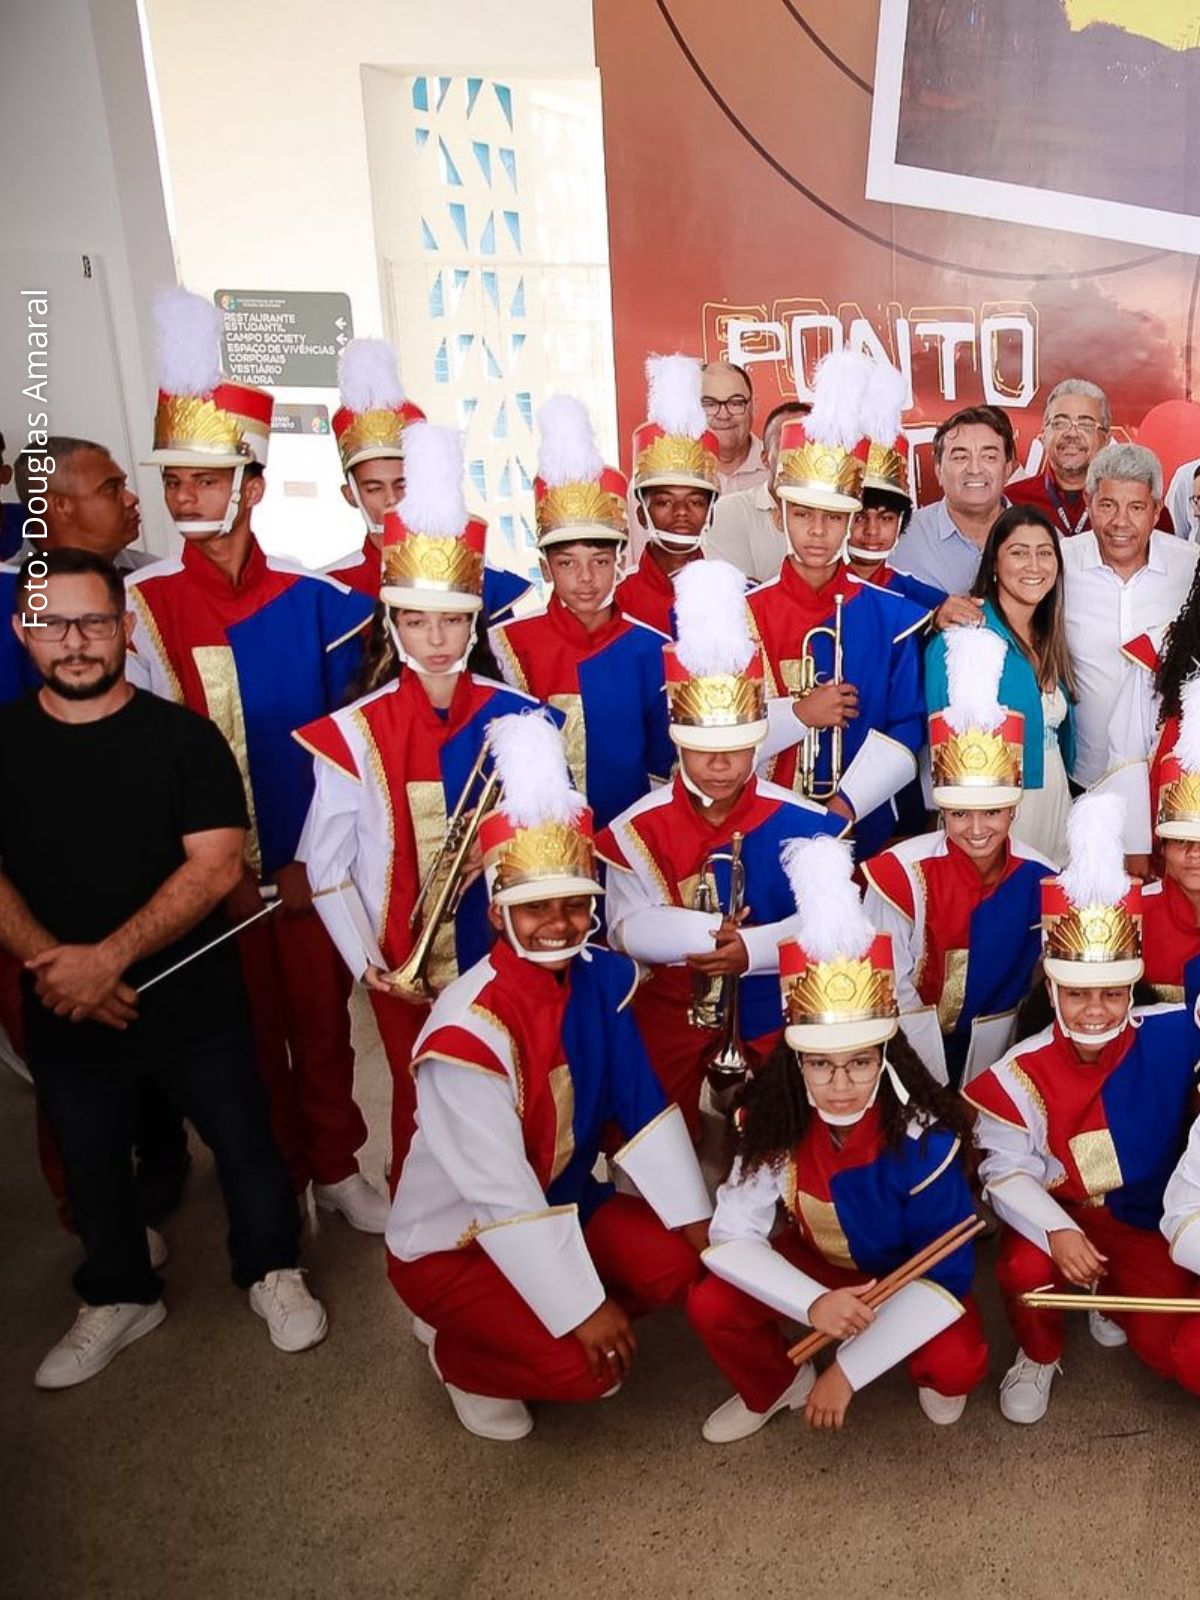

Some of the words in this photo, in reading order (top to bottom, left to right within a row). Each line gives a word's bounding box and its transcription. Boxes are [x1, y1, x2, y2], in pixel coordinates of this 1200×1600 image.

[224, 313, 296, 324] RESTAURANTE
[225, 323, 286, 332] ESTUDANTIL
[226, 332, 263, 342] CAMPO
[264, 333, 306, 344] SOCIETY
[227, 343, 267, 354] ESPAÇO
[267, 344, 281, 354] DE
[282, 343, 335, 355] VIVÊNCIAS
[228, 354, 286, 364] CORPORAIS
[727, 313, 1037, 409] PONTO
[230, 363, 282, 374] VESTIÁRIO
[230, 374, 275, 385] QUADRA
